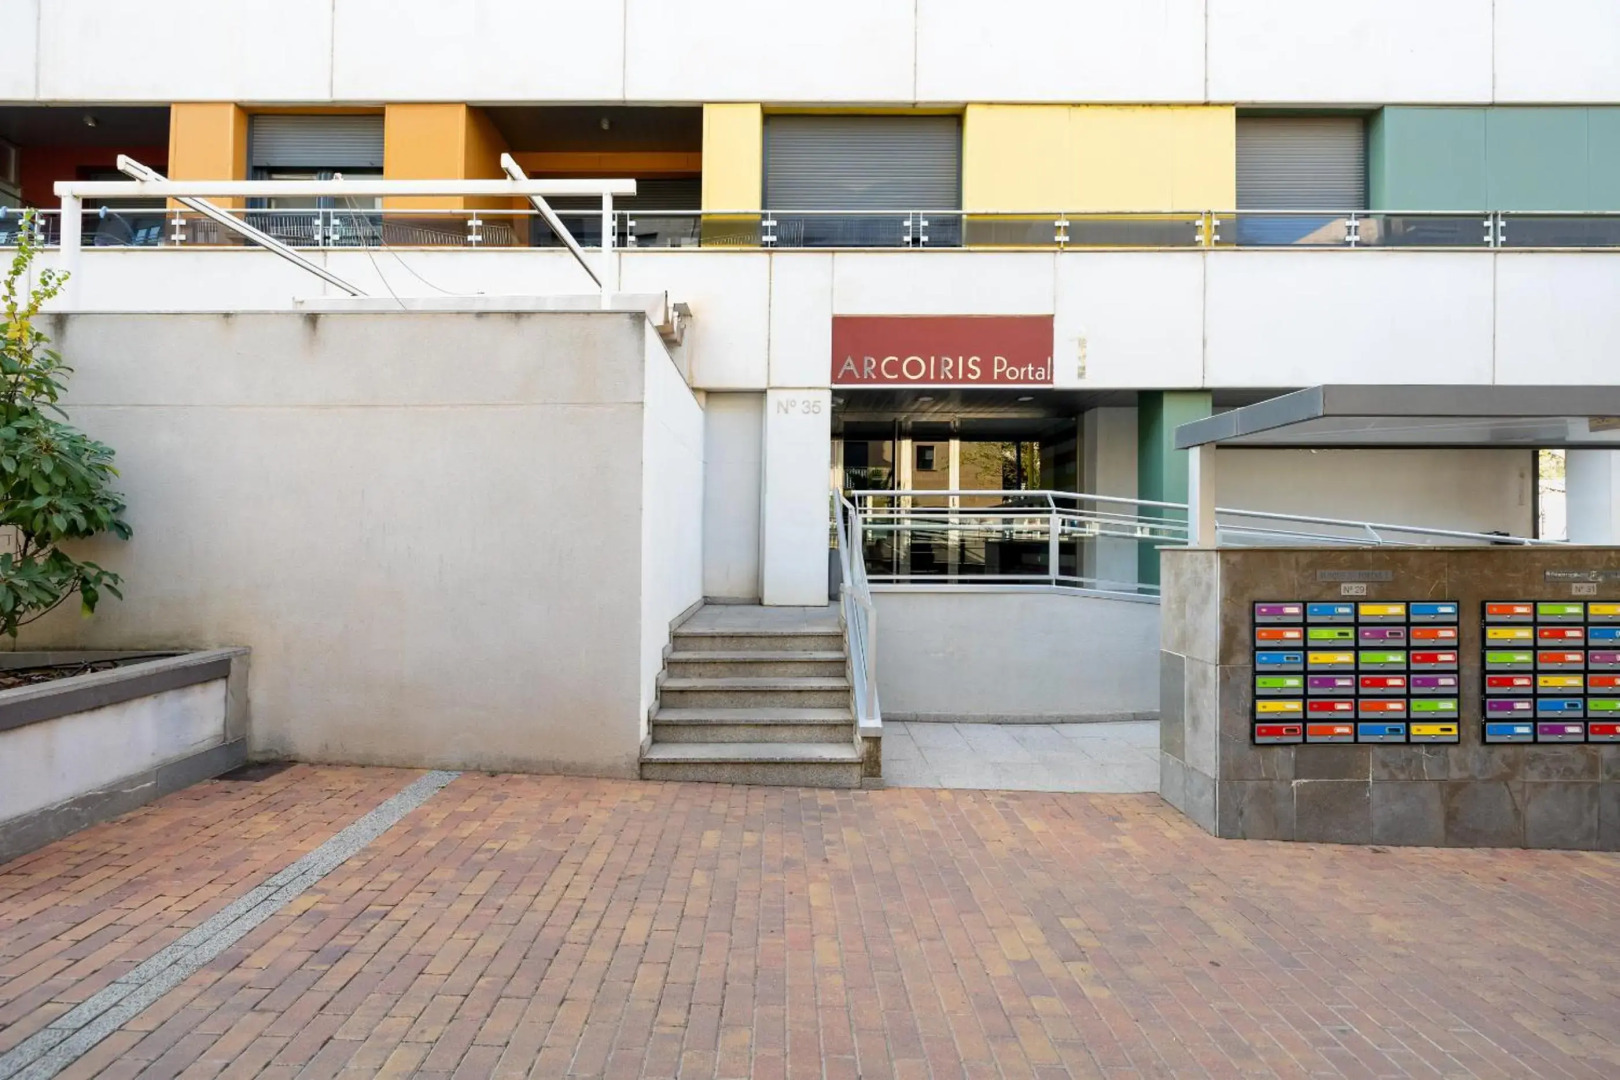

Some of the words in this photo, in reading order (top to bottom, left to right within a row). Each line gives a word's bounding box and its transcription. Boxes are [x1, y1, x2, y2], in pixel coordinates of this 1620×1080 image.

[837, 355, 982, 380] ARCOIRIS
[993, 355, 1052, 381] Portal
[801, 400, 822, 415] 35
[1354, 585, 1365, 594] 29
